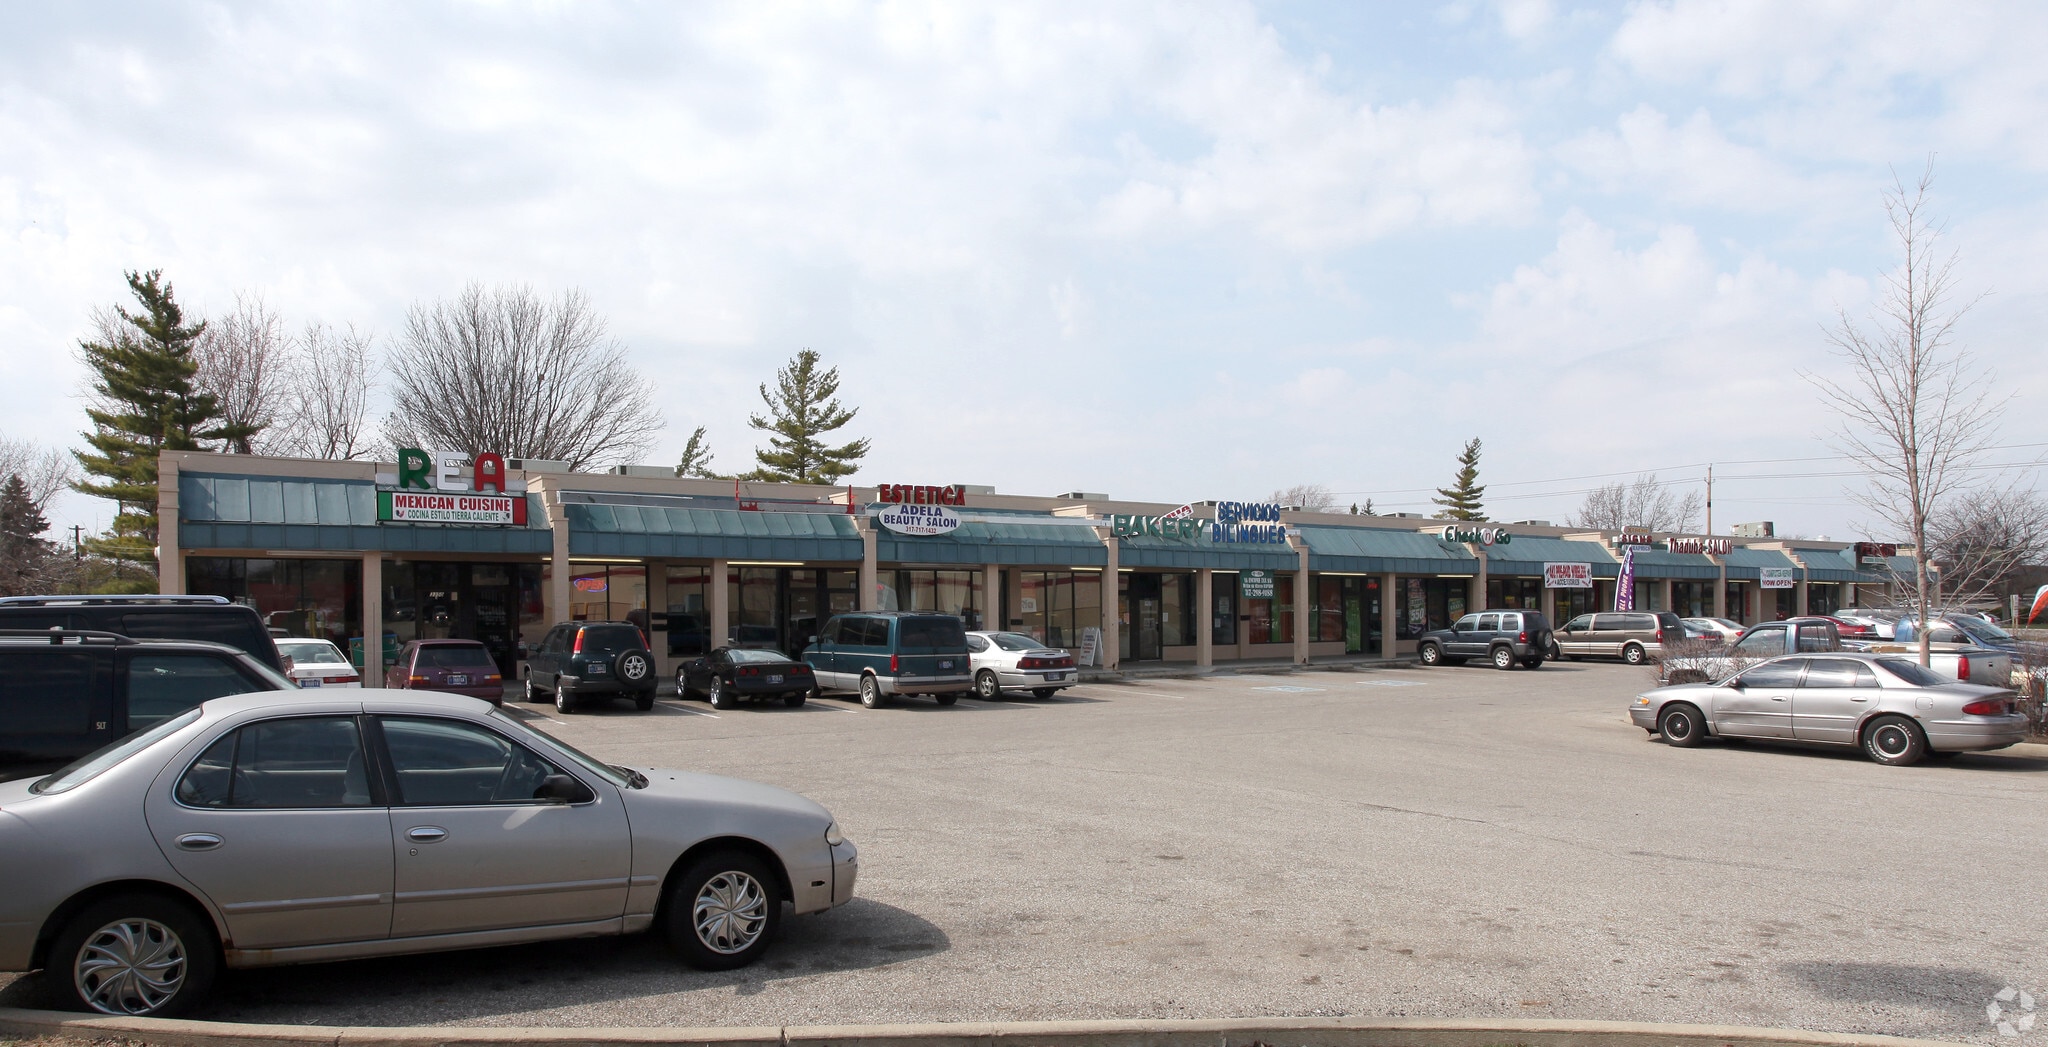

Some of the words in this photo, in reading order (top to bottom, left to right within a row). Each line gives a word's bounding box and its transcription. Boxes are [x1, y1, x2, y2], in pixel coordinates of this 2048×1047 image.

[398, 448, 506, 493] REA
[395, 495, 454, 510] MEXICAN
[459, 497, 511, 512] CUISINE
[879, 484, 966, 506] ESTETICA
[407, 509, 430, 519] COCINA
[430, 510, 451, 520] ESTILO
[451, 511, 472, 521] TIERRA
[472, 512, 499, 521] CALIENTE
[900, 505, 943, 517] ADELA
[1216, 501, 1281, 523] SERVICIOS
[884, 514, 922, 526] BEAUTY
[926, 516, 957, 528] SALON
[1111, 514, 1206, 539] BAKERY
[1211, 523, 1287, 545] BILINGUES
[1442, 525, 1482, 544] Check
[1493, 528, 1512, 545] Go
[1620, 533, 1653, 544] SIGNS
[1667, 537, 1704, 555] Thaduba
[1705, 538, 1733, 556] SALON
[577, 579, 605, 592] OPEN
[1620, 573, 1629, 598] PHONE
[1762, 579, 1775, 587] NOW
[1776, 579, 1792, 587] OPEN
